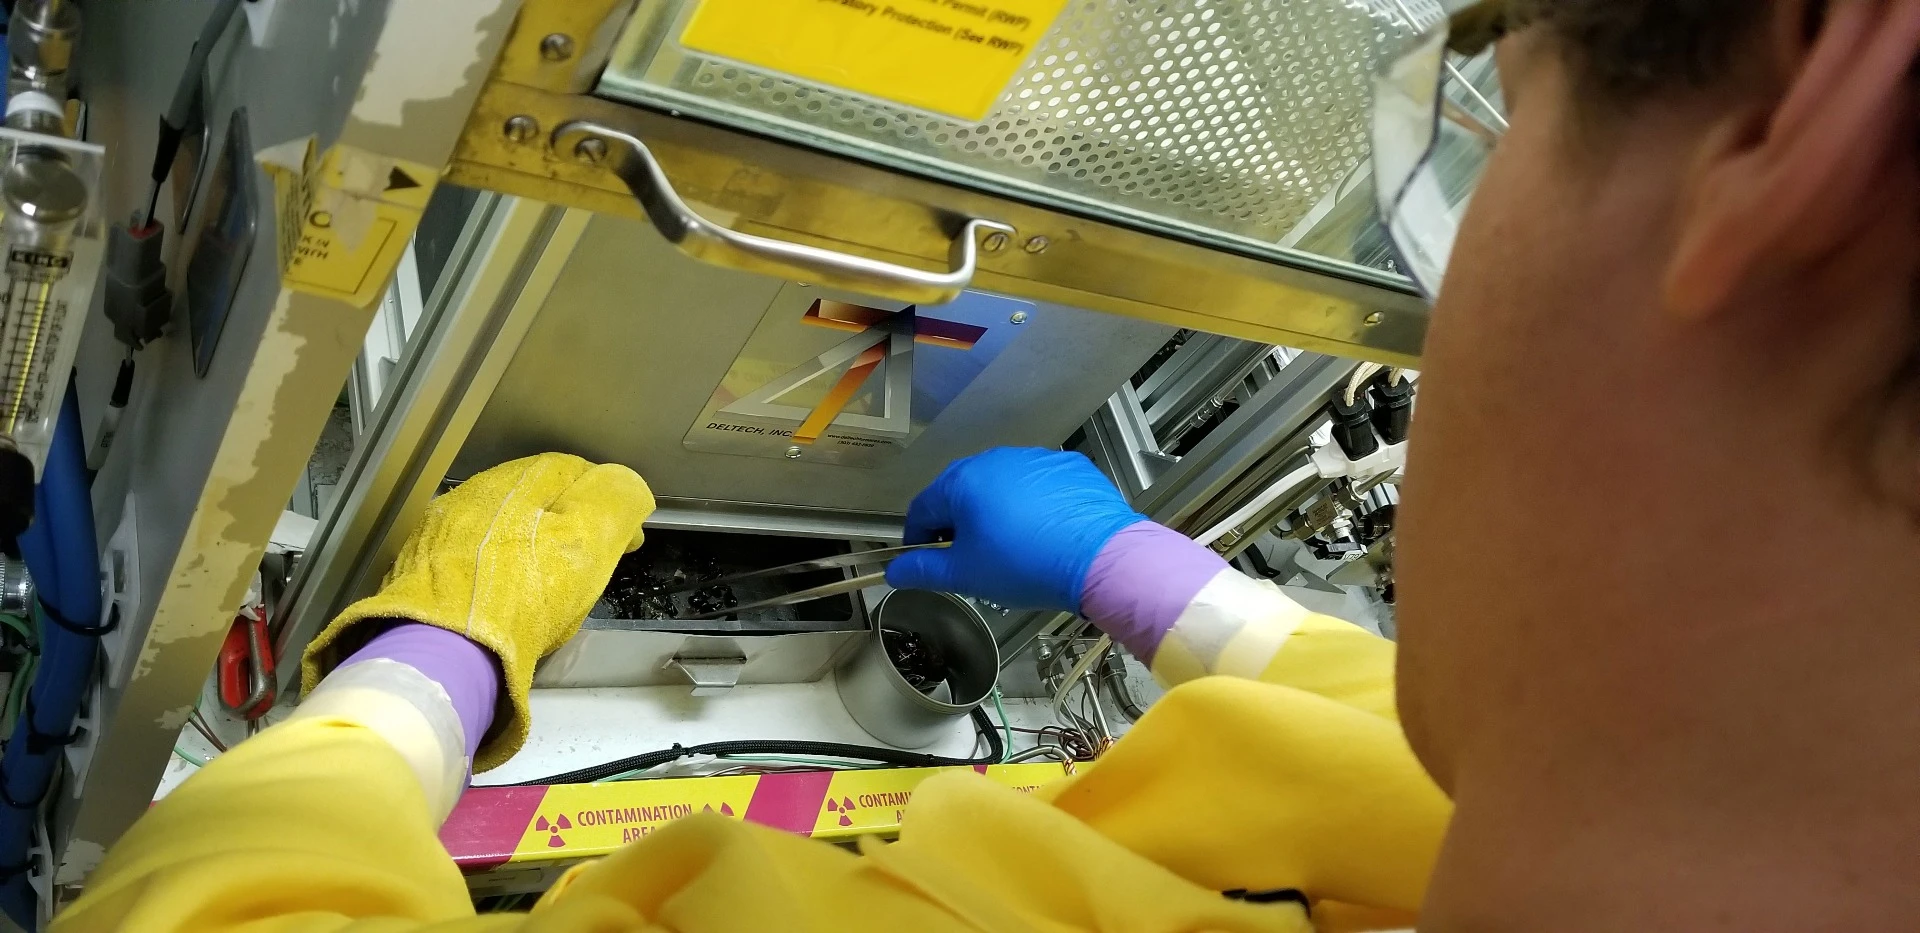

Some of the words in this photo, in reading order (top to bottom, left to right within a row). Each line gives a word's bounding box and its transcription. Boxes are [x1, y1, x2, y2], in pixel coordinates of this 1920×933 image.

[706, 422, 765, 436] DELTECH,
[768, 429, 793, 437] INC.
[577, 803, 692, 827] CONTAMINATION
